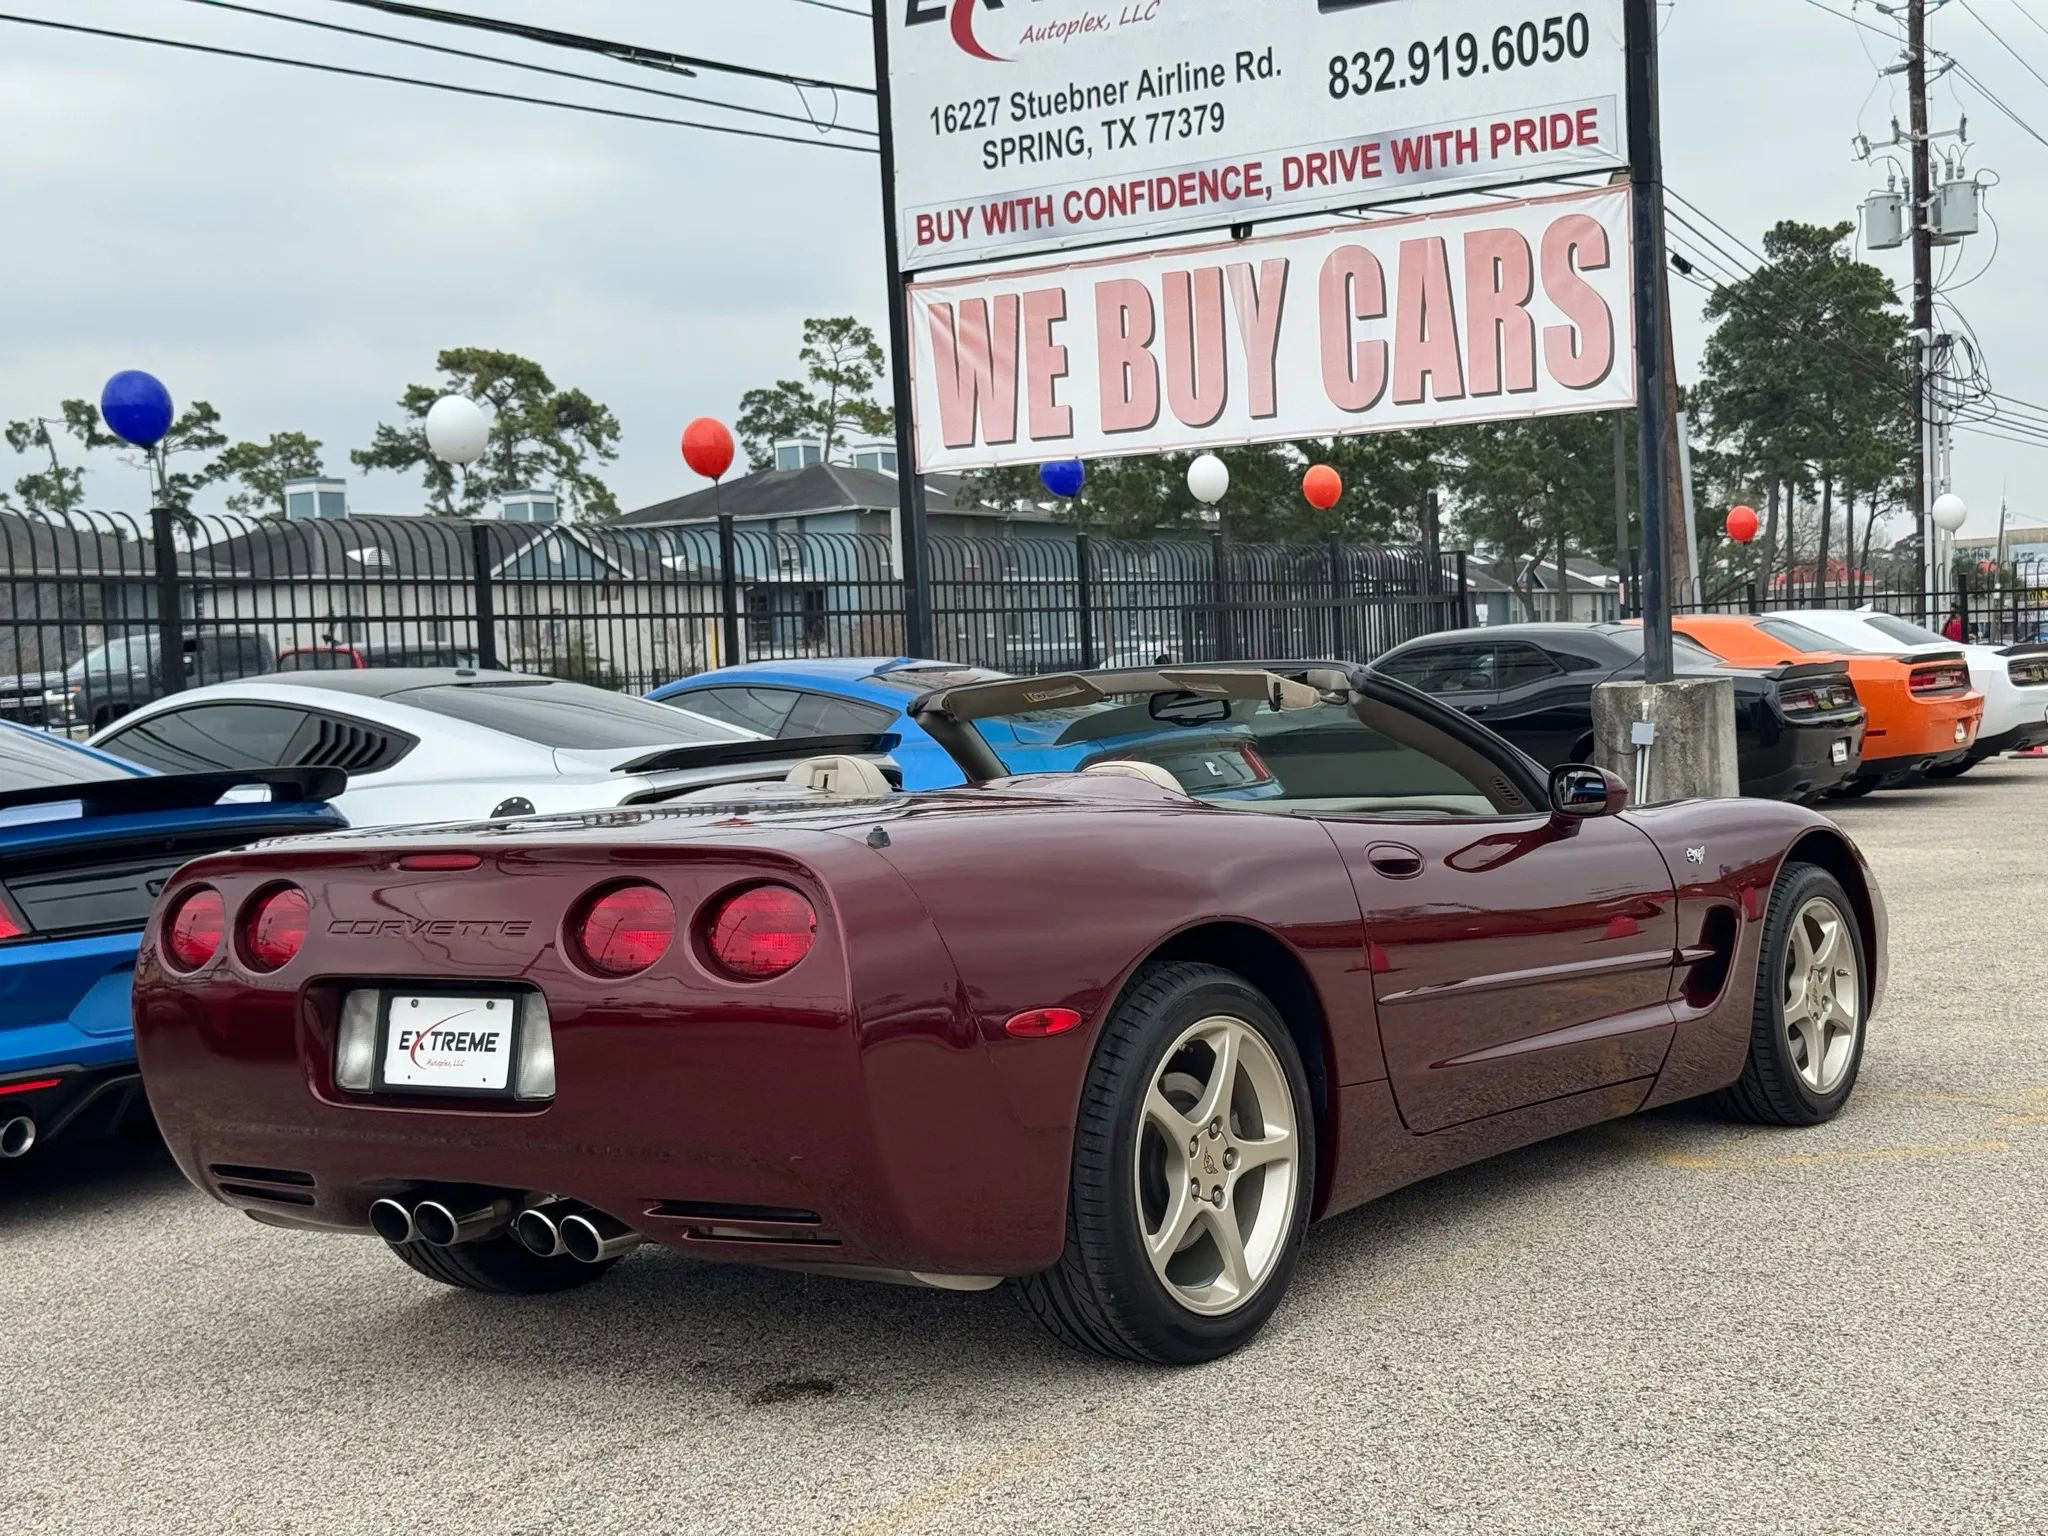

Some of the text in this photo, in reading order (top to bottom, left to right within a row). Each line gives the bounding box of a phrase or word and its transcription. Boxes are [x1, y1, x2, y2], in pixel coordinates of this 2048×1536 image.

[1018, 11, 1111, 45] Autoplex,
[1119, 1, 1160, 26] LLC
[1328, 12, 1590, 100] 832.919.6050
[930, 46, 1282, 136] 16227 Stuebner Airline Rd.
[982, 102, 1225, 170] SPRING, TX 77379
[916, 108, 1599, 246] BUY WITH CONFIDENCE, DRIVE WITH PRIDE
[927, 213, 1615, 449] WE BUY CARS
[327, 920, 533, 937] CORVETTE
[398, 1030, 500, 1053] EXTREME
